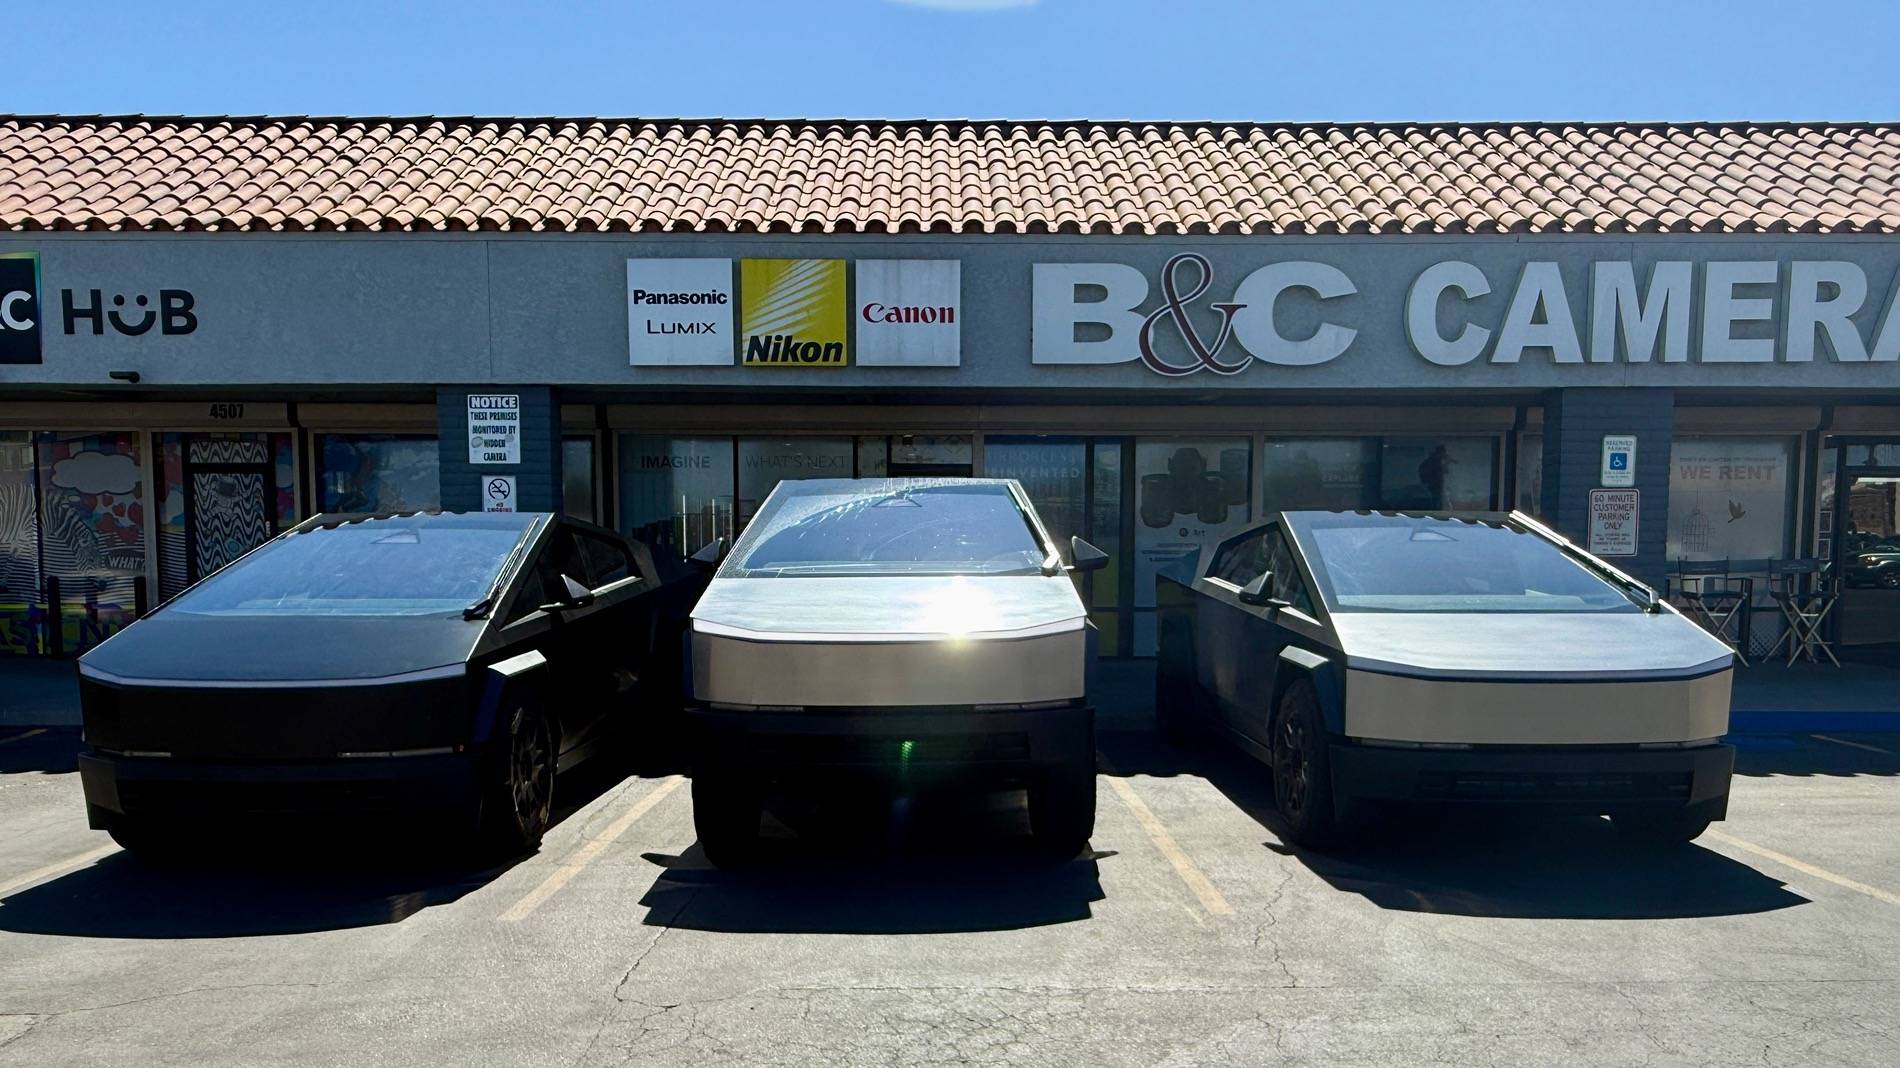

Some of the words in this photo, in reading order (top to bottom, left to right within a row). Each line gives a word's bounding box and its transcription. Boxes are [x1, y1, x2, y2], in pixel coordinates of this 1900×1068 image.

[632, 288, 728, 306] Panasonic
[0, 289, 35, 331] C
[862, 302, 955, 324] Canon
[1031, 252, 1358, 377] B&C
[646, 319, 717, 335] LUMIX
[745, 335, 844, 363] Nikon
[470, 396, 517, 409] NOTICE
[210, 403, 243, 419] 4507
[470, 411, 488, 421] THESE
[489, 411, 517, 421] PREMISES
[472, 425, 507, 434] MONITORED
[508, 425, 517, 434] BY
[483, 439, 506, 448] HIDDEN
[483, 452, 507, 461] CAMERA
[641, 455, 711, 469] IMAGINE
[746, 455, 803, 469] WHAT'S
[807, 455, 847, 469] NEXT
[1679, 464, 1712, 480] WE
[1718, 464, 1776, 481] RENT
[1594, 494, 1605, 503] 60
[1607, 494, 1635, 503] MINUTE
[1593, 503, 1635, 512] CUSTOMER
[1598, 512, 1630, 521] PARKING
[1603, 521, 1623, 530] ONLY
